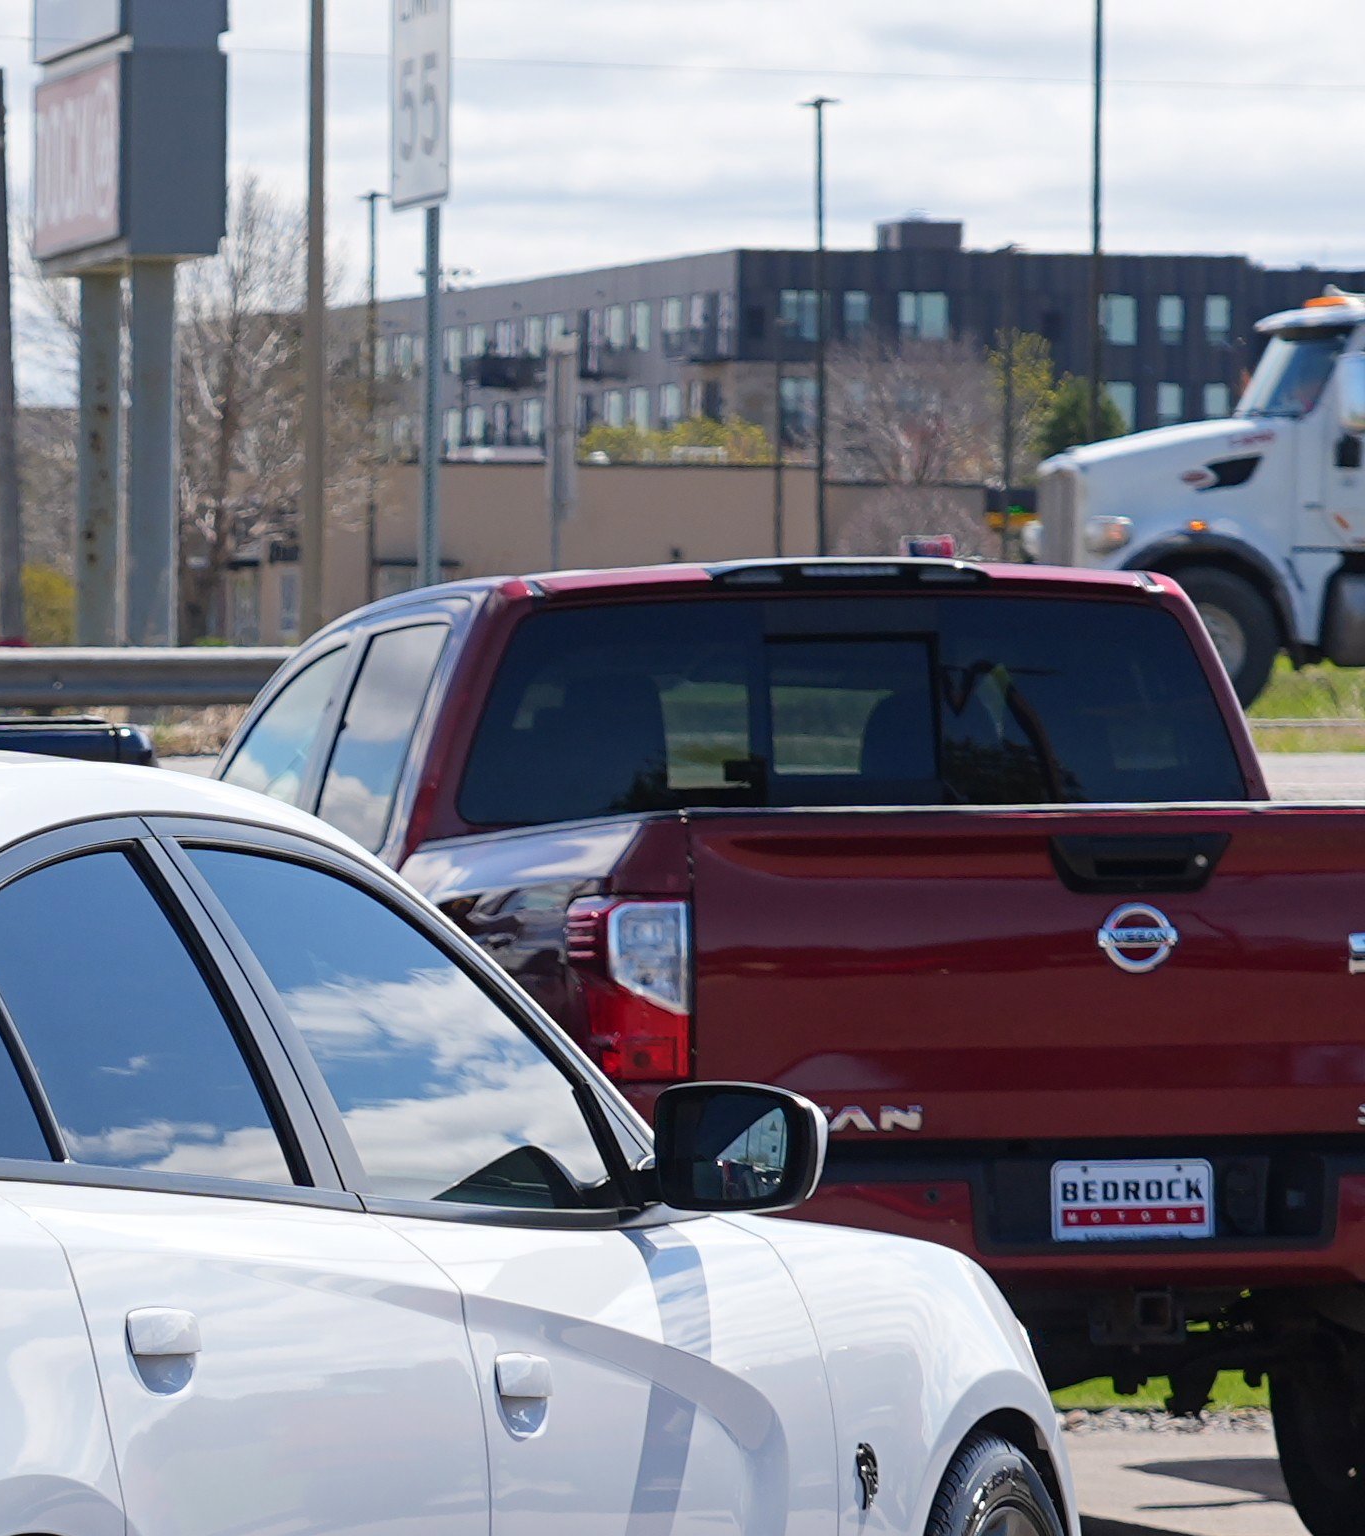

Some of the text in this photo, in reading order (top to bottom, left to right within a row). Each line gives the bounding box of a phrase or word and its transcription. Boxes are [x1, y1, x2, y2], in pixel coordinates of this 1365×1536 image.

[400, 52, 441, 161] 55
[1108, 931, 1169, 943] NISSAN
[1061, 1177, 1205, 1203] BEDROCK
